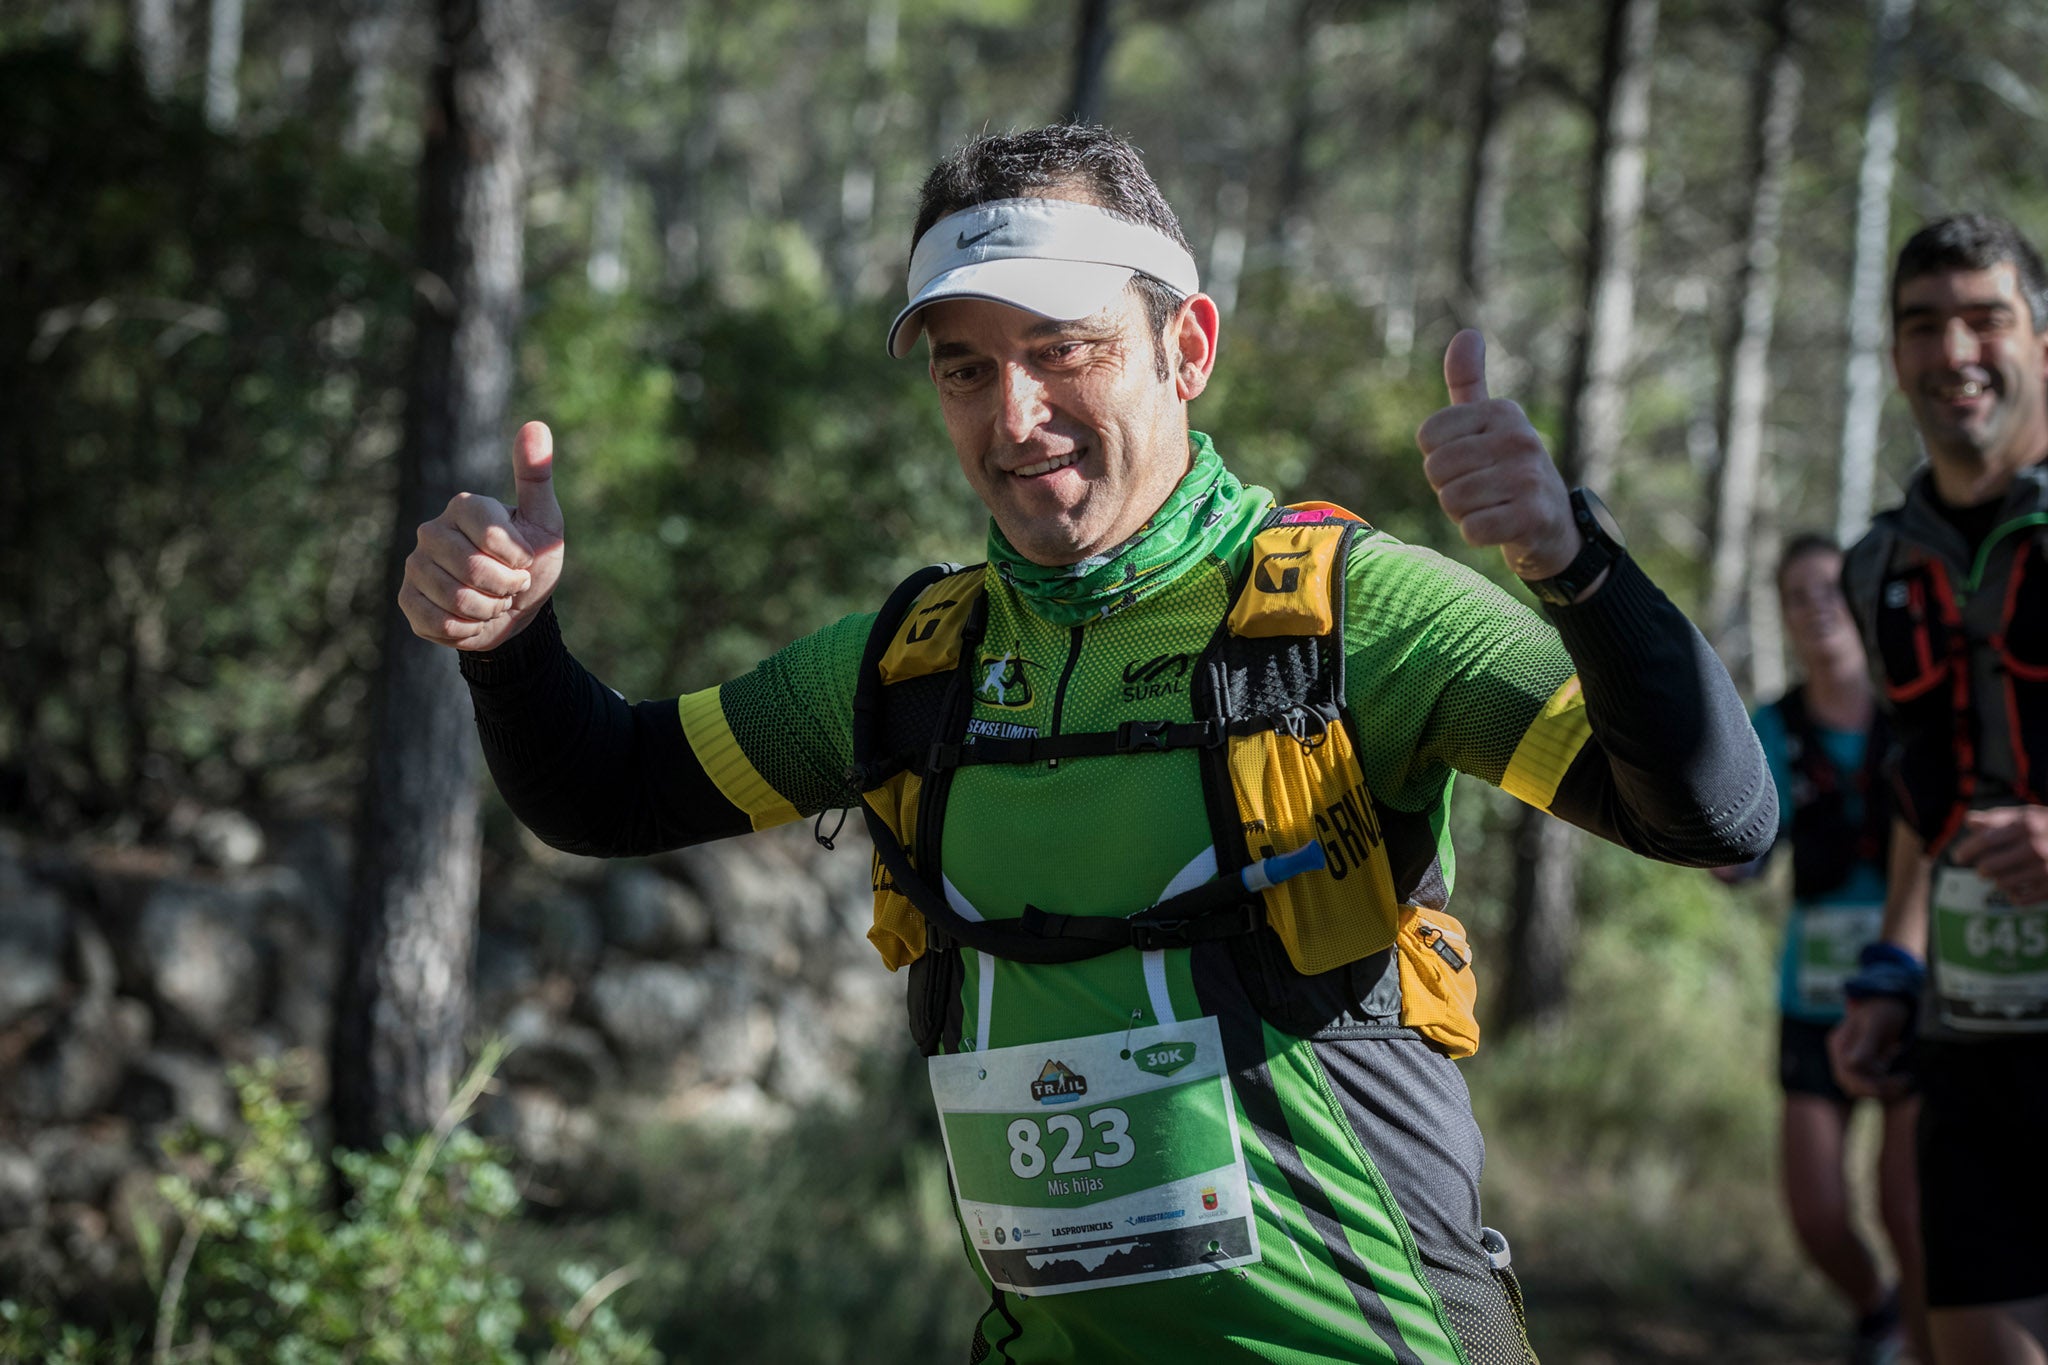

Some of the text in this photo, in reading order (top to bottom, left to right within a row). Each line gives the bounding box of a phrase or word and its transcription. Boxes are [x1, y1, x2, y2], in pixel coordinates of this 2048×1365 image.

[1123, 680, 1184, 702] SURAL
[967, 718, 1039, 740] SENSE LIMITS
[1965, 915, 2045, 956] 645
[1147, 1049, 1184, 1067] 30K
[1034, 1077, 1084, 1096] TRAIL
[1006, 1107, 1136, 1180] 823
[1048, 1176, 1104, 1197] Mis hijas
[1052, 1221, 1113, 1237] LASPROVINCIAS
